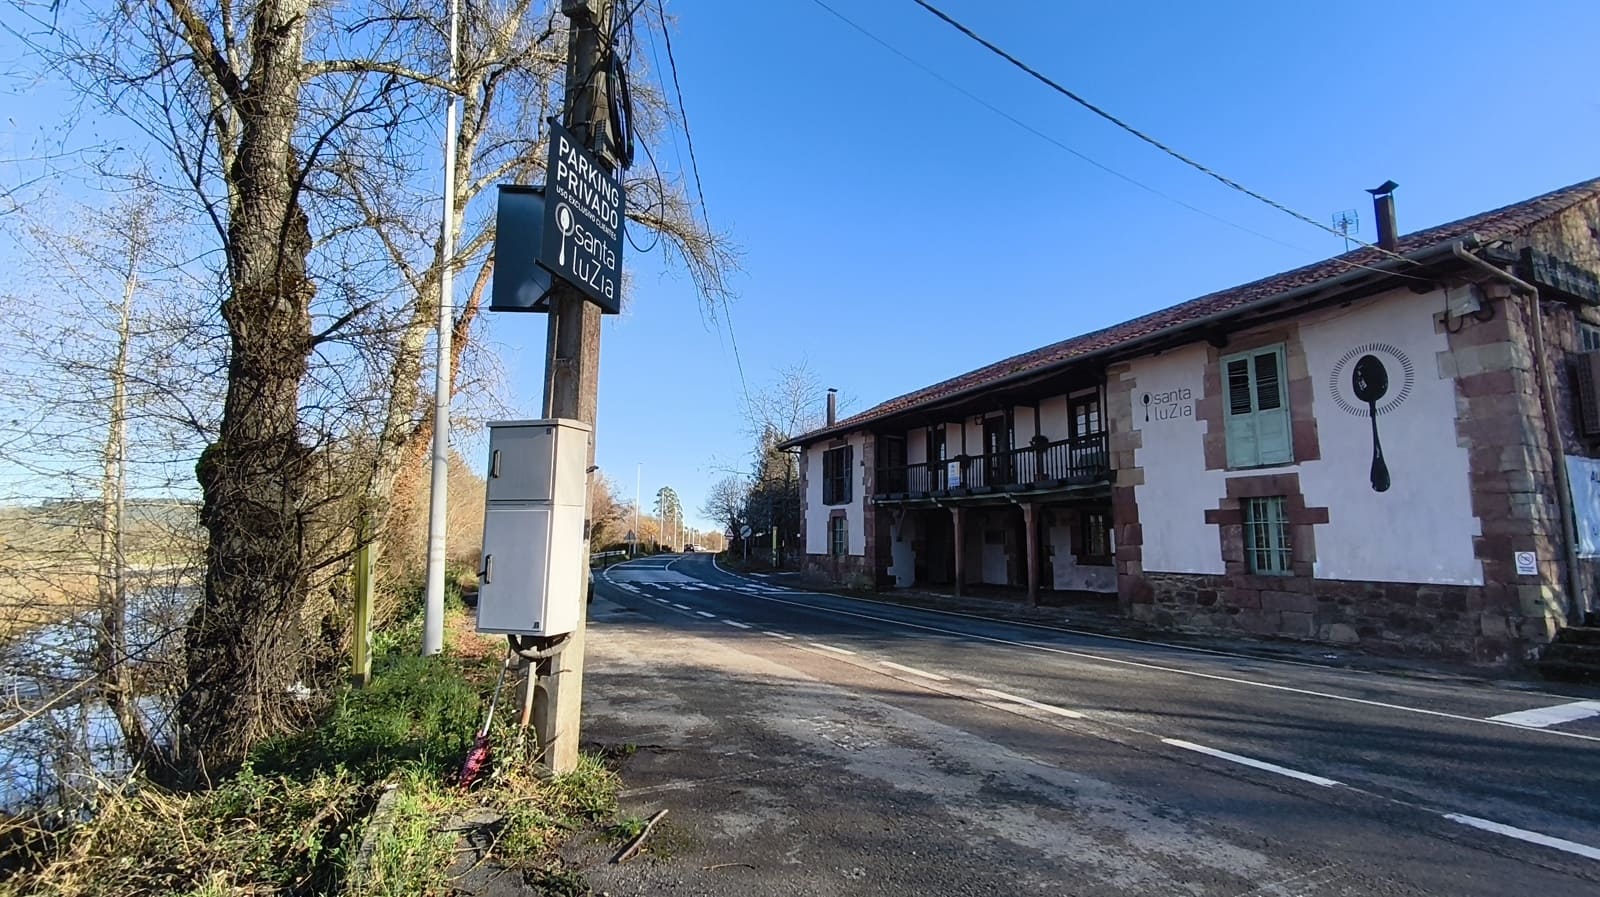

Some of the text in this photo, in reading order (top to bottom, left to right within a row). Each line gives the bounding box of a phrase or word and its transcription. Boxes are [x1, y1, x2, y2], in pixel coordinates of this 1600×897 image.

[557, 161, 618, 230] PRIVADO
[559, 135, 619, 208] PARKING
[556, 184, 617, 241] USO EXCLUSIVO CLIENTES
[574, 224, 615, 271] santa
[1154, 387, 1192, 405] santa
